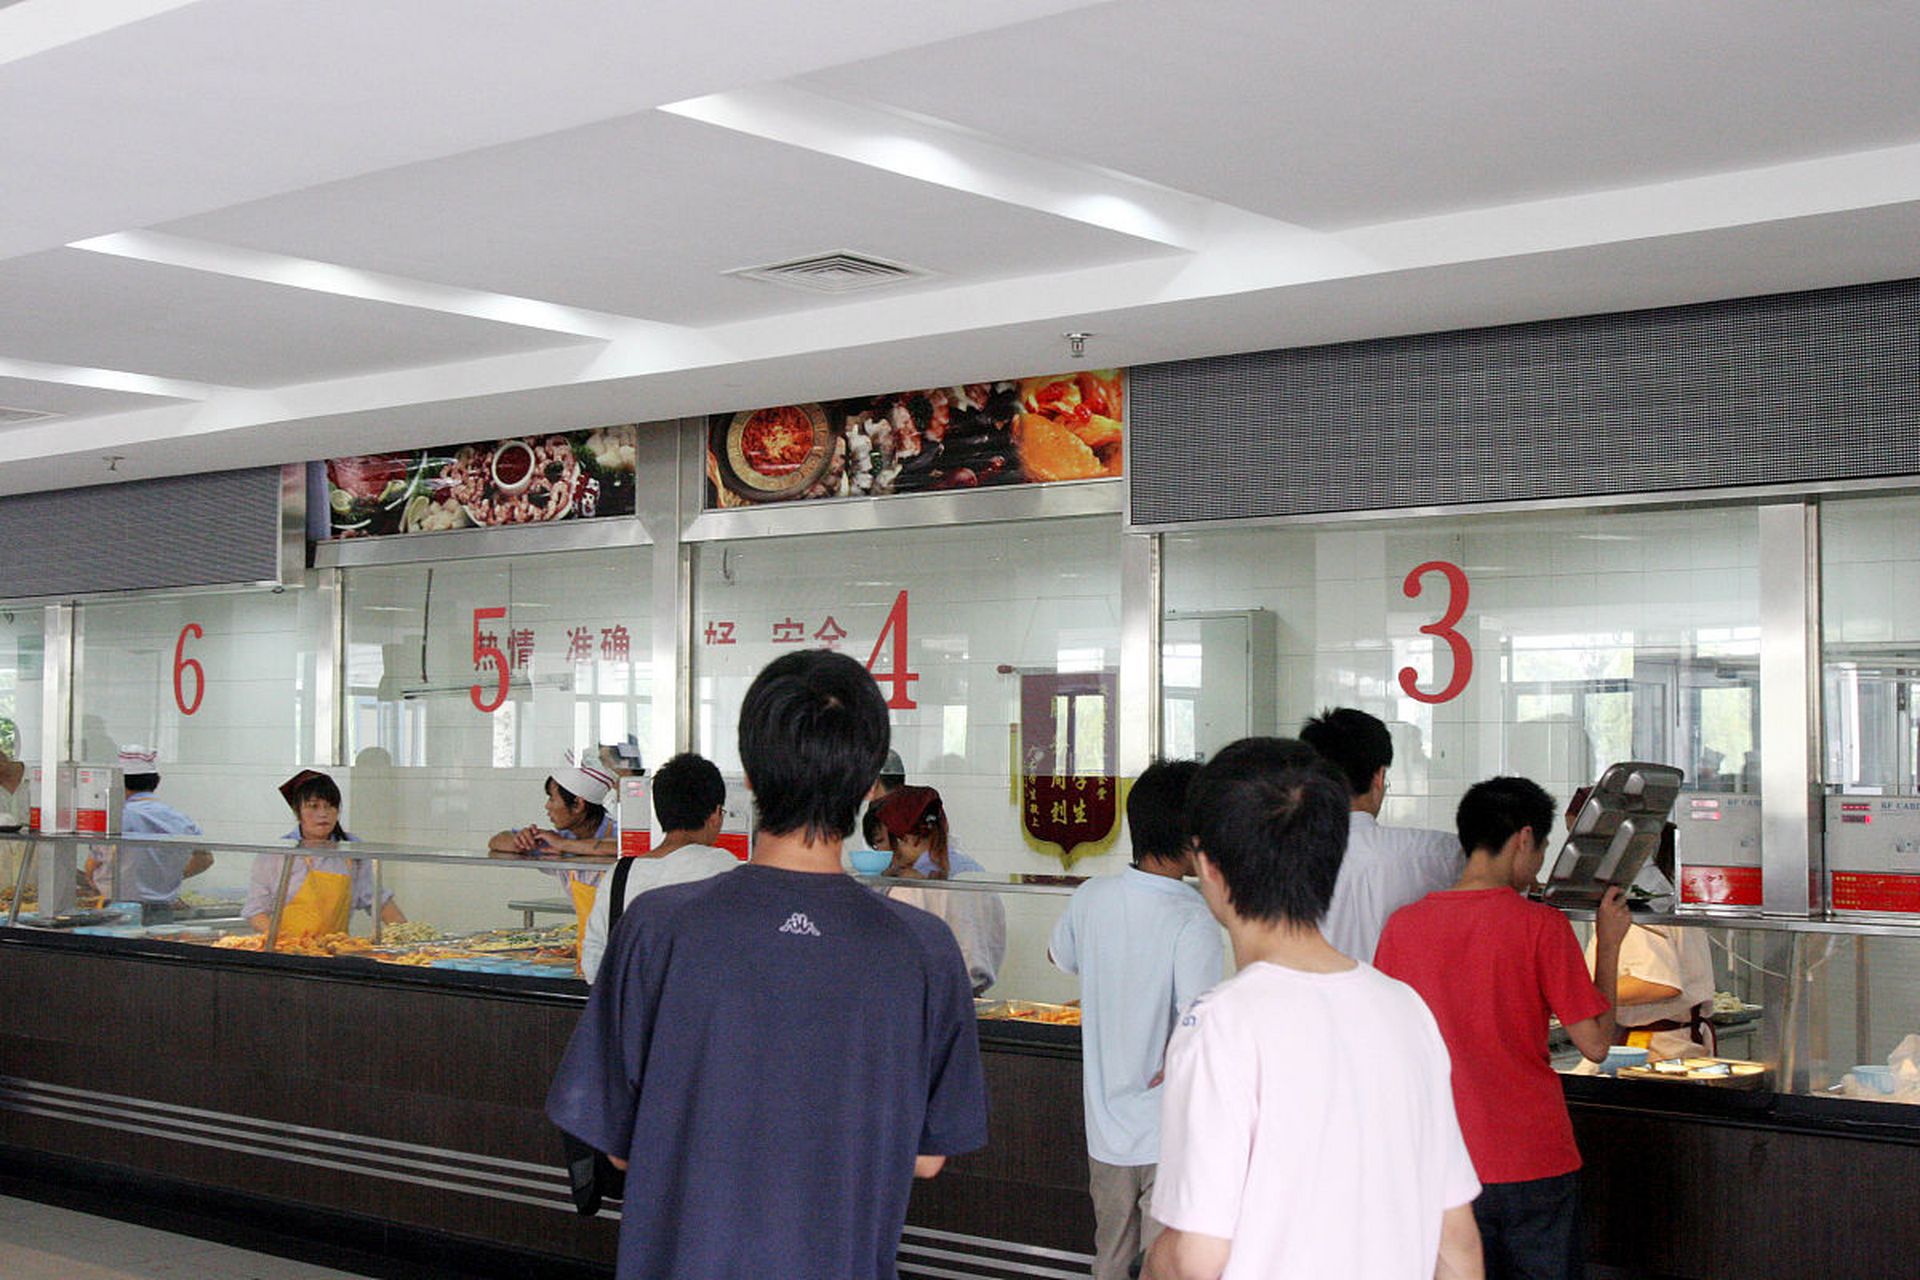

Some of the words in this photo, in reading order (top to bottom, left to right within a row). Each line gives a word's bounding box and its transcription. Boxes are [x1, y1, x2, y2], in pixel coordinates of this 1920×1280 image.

[173, 623, 205, 716] 6
[470, 607, 510, 713] 5
[566, 623, 630, 664] 准确
[865, 590, 919, 709] 4
[1398, 560, 1473, 704] 3
